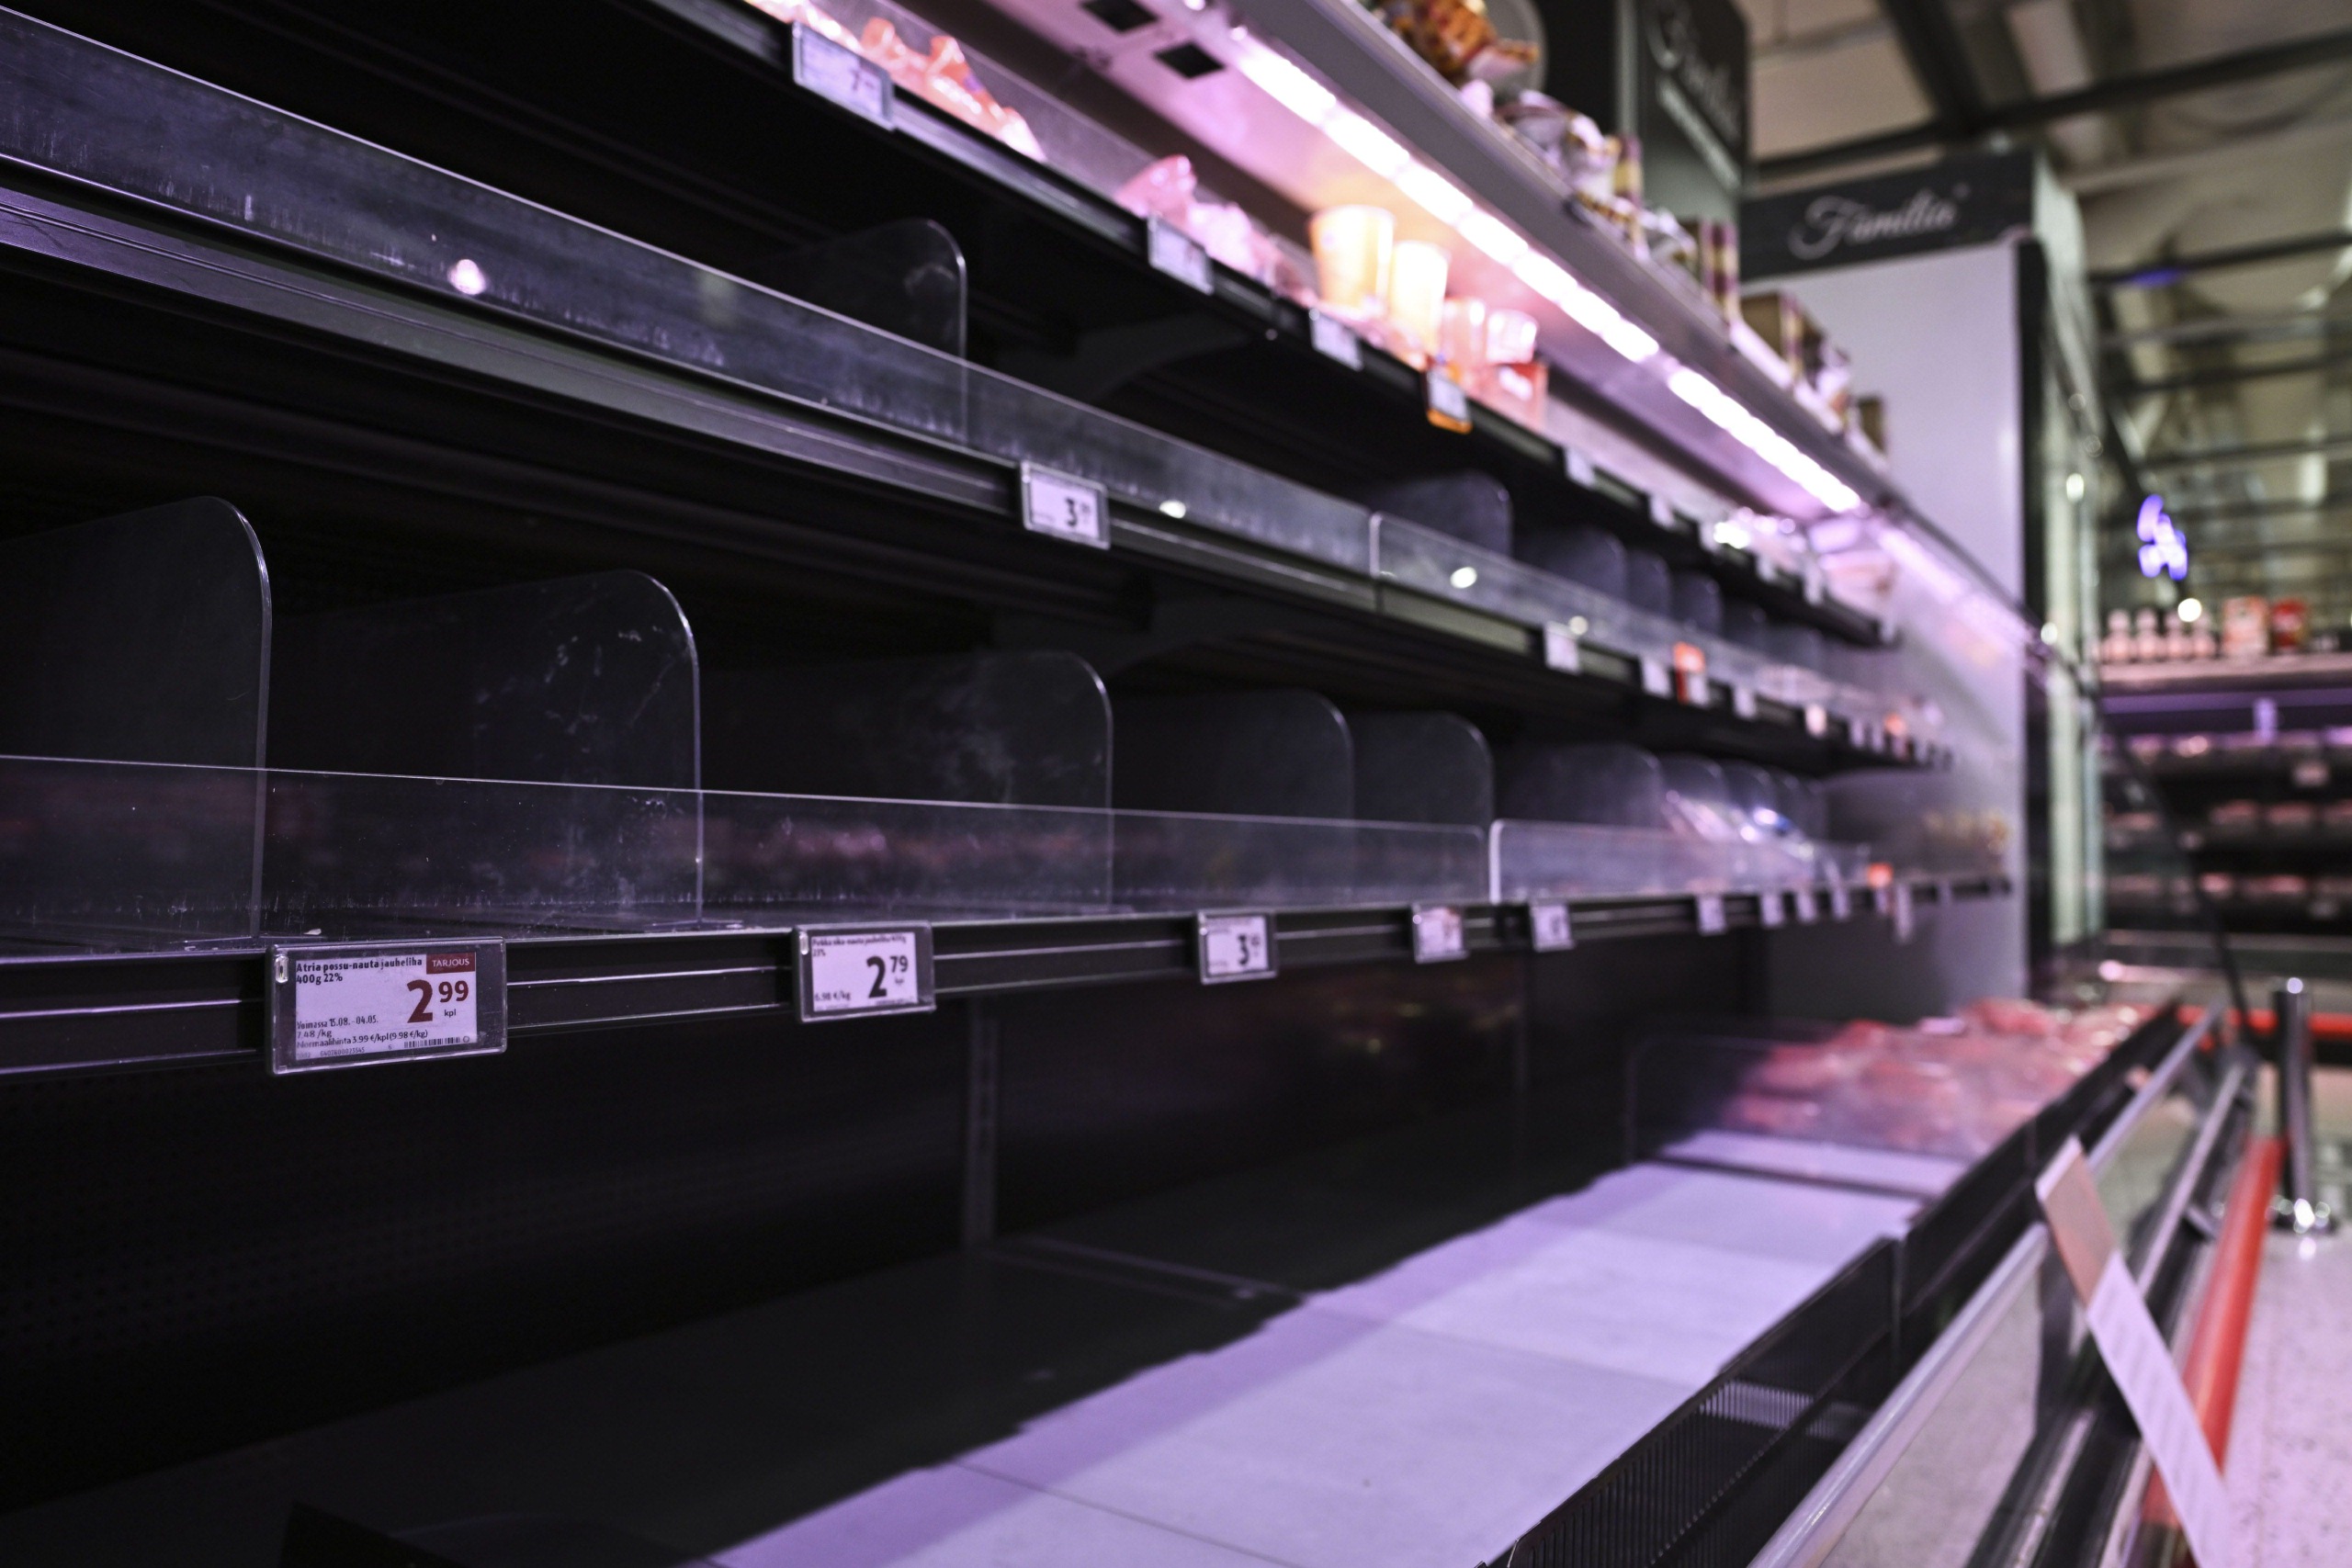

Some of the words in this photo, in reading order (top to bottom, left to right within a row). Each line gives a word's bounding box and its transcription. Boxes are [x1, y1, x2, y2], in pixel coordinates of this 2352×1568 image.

[1787, 186, 1960, 260] Familia
[1064, 496, 1078, 527] 3
[1238, 933, 1251, 965] 3
[297, 963, 322, 973] Atria
[323, 959, 379, 973] possu-nauta
[380, 956, 423, 970] jauheliha
[433, 958, 470, 967] TARJOUS
[296, 974, 322, 986] 400g
[323, 972, 343, 983] 22%
[866, 955, 888, 998] 2
[889, 955, 909, 974] 79
[407, 979, 434, 1024] 2
[438, 980, 469, 1003] 99
[297, 1021, 328, 1030] Voimassa
[356, 1015, 379, 1025] 04.05.
[444, 1009, 457, 1019] kpl
[296, 1037, 352, 1049] Normaalihinta
[352, 1035, 369, 1044] 3.99
